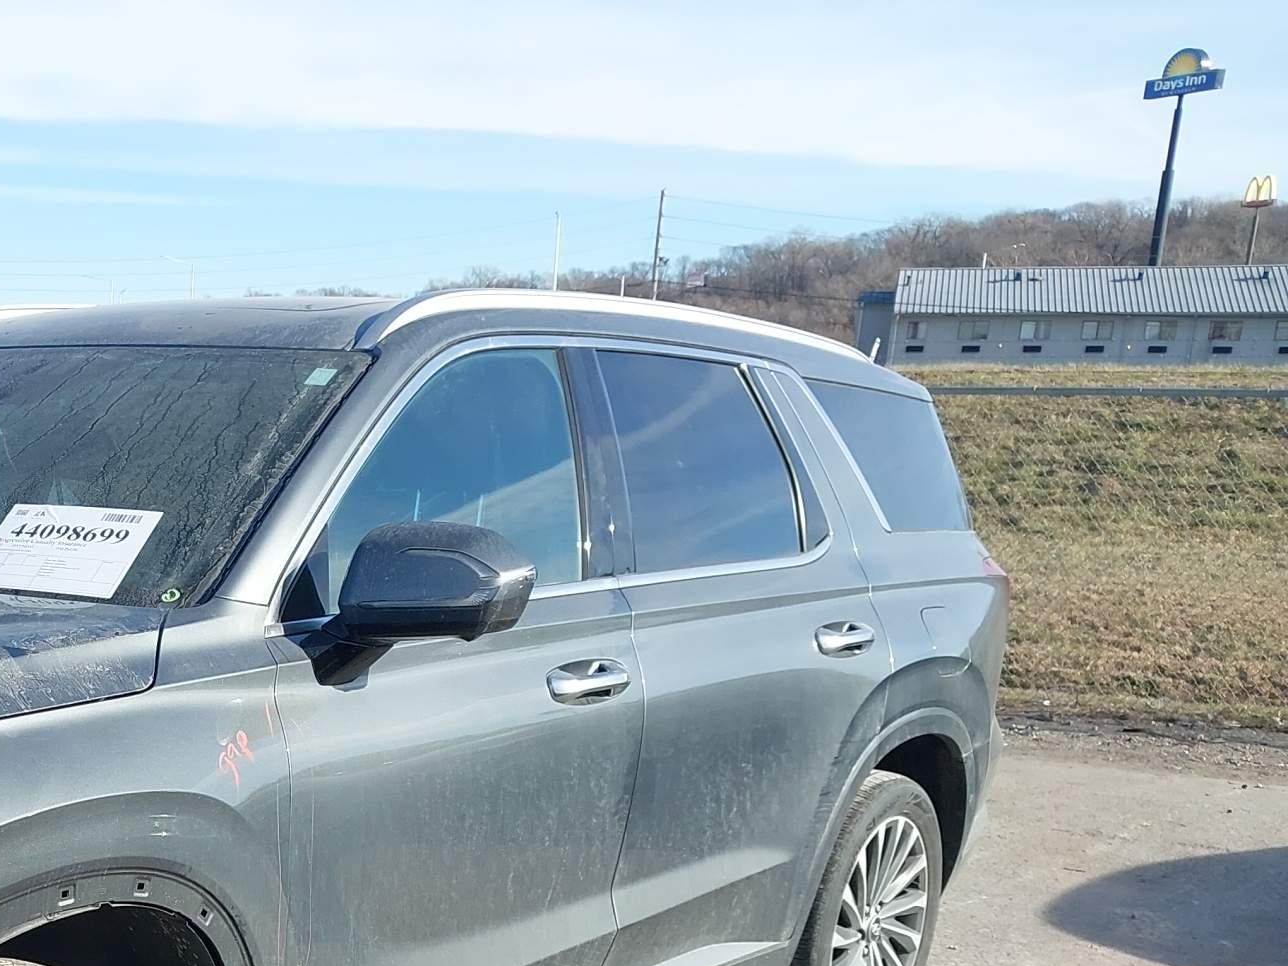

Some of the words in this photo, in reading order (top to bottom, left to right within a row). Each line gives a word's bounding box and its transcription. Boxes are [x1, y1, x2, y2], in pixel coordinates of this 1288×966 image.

[1154, 79, 1184, 92] Days
[1185, 74, 1207, 86] Inn
[10, 522, 130, 545] 44098699
